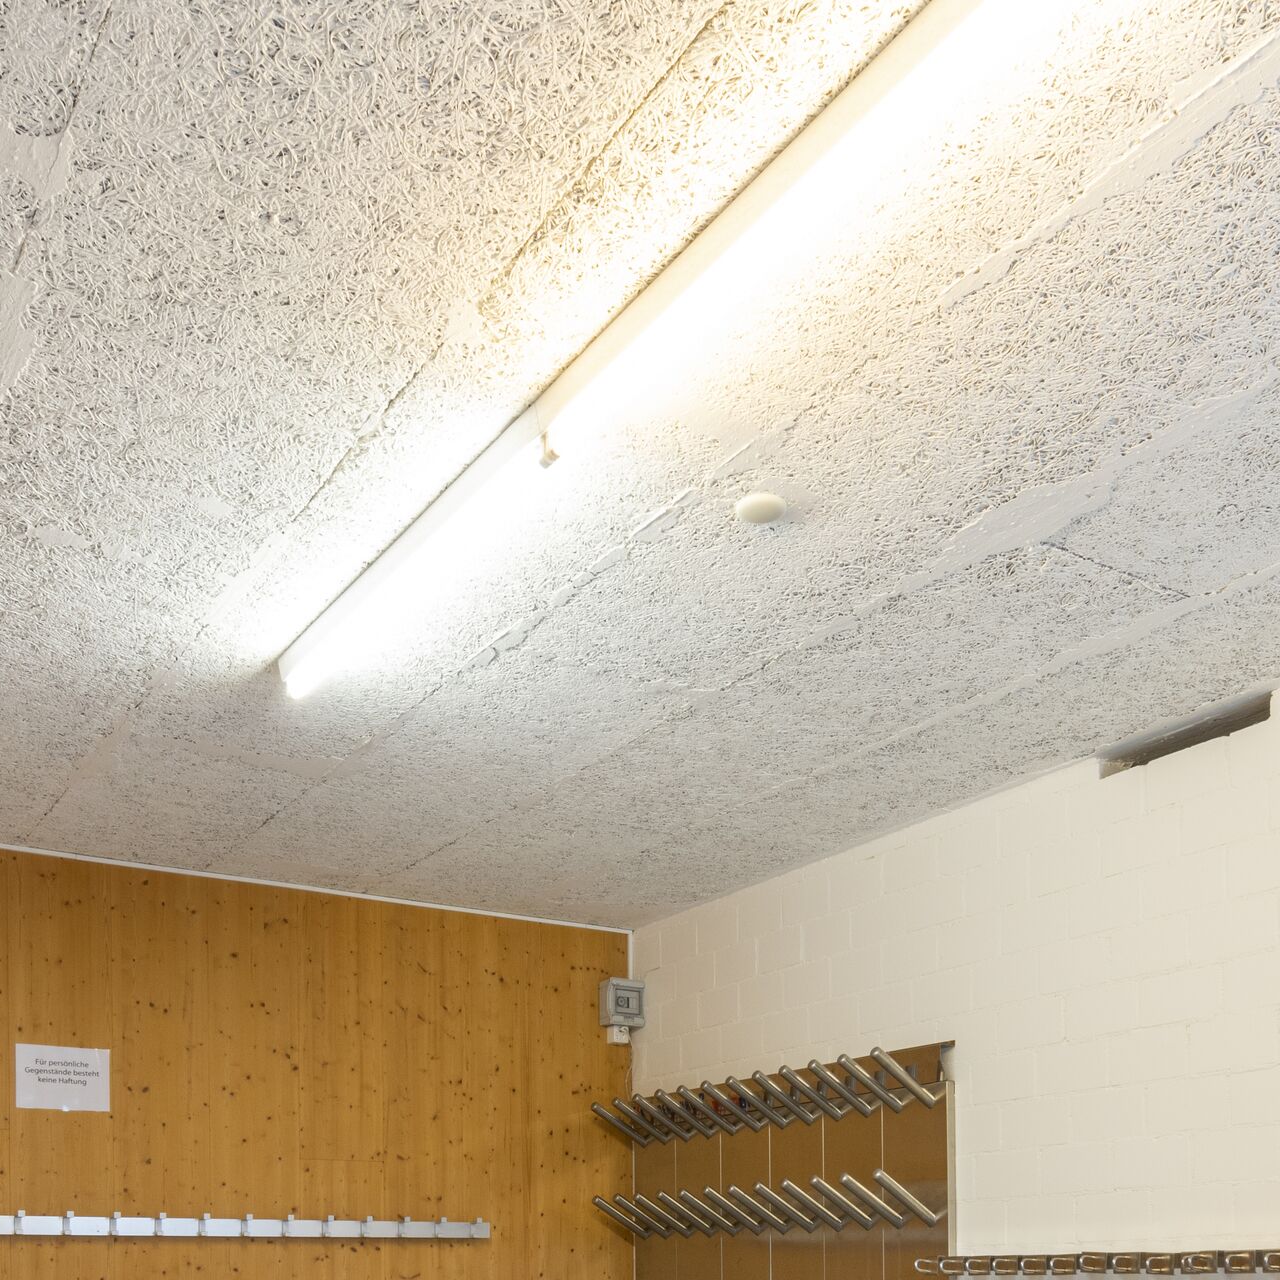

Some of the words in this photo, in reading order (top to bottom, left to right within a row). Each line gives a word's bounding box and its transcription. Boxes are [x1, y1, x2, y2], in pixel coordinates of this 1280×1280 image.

[35, 1058, 47, 1066] Für
[48, 1060, 89, 1069] persönliche
[24, 1066, 72, 1076] Gegenstände
[73, 1069, 100, 1078] besteht
[37, 1076, 57, 1084] keine
[58, 1077, 88, 1087] Haftung
